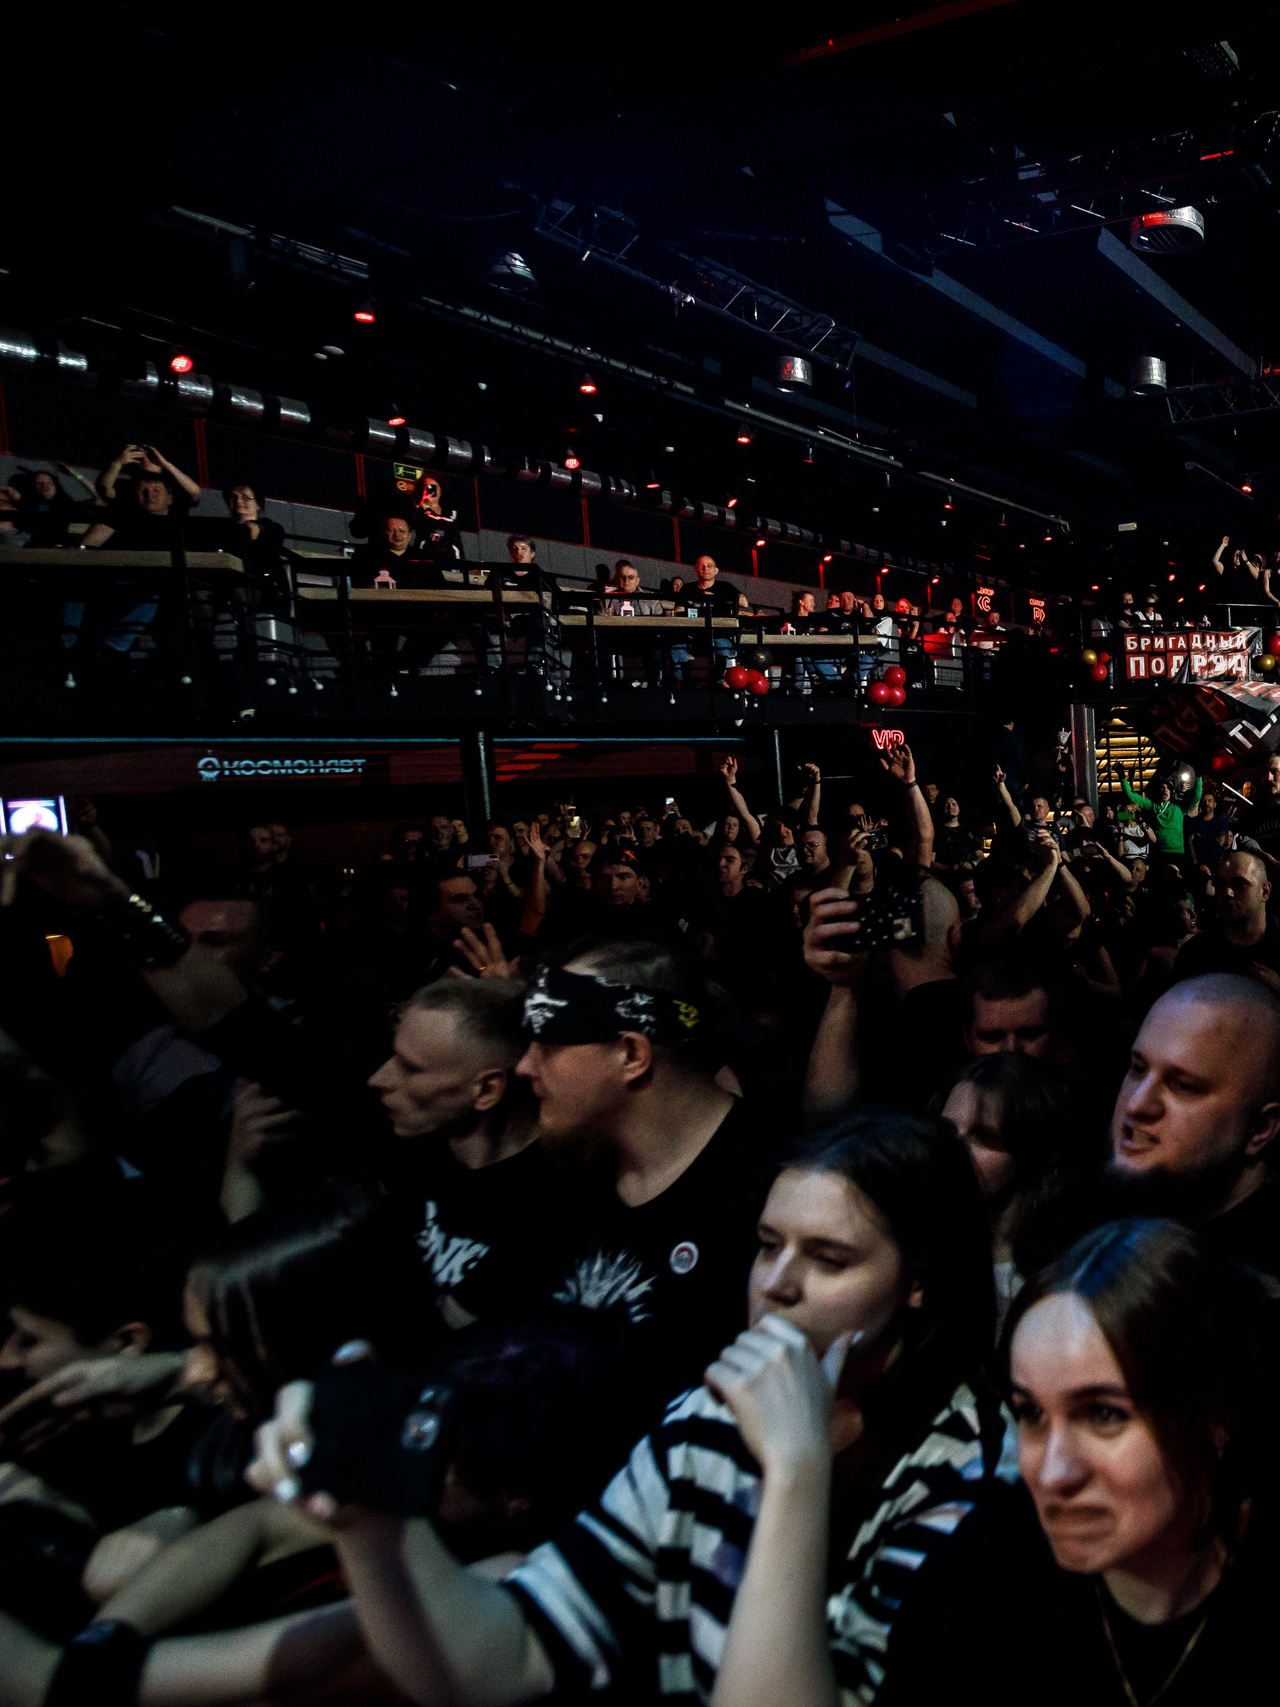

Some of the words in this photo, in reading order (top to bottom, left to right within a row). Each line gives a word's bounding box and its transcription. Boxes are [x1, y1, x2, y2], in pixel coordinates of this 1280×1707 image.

[1126, 633, 1247, 651] БРИГАДНЫЙ
[1129, 651, 1247, 677] ПОДРЯД
[222, 758, 367, 776] КОСМОНАВТ
